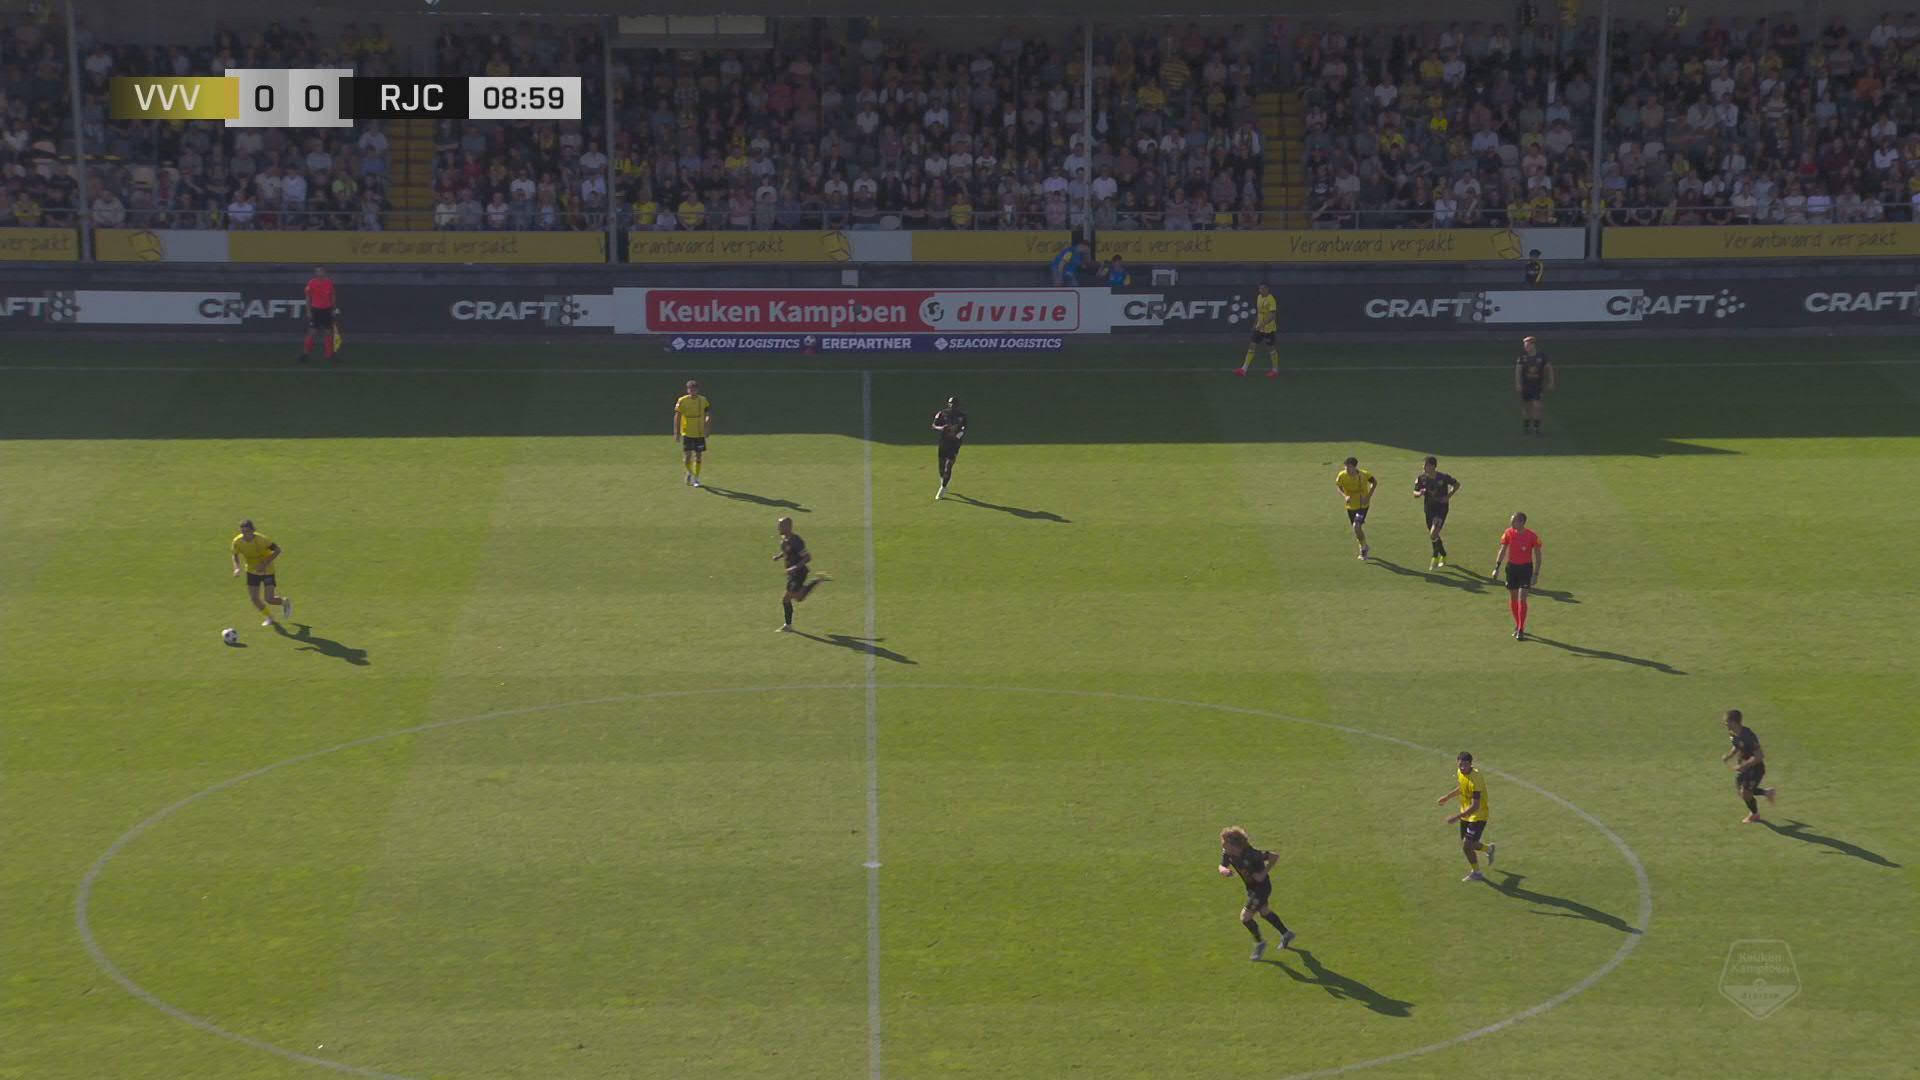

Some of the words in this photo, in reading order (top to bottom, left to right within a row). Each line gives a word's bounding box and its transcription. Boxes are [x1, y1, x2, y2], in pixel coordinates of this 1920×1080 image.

[1390, 234, 1456, 256] verpakt
[0, 297, 48, 316] AFT
[198, 298, 307, 319] CRAFT
[452, 300, 560, 320] CRAFT
[1123, 300, 1227, 320] CRAFT
[1364, 298, 1472, 318] CRAFT
[1605, 295, 1715, 316] CRAFT
[1804, 291, 1916, 312] CRAFT
[658, 299, 760, 323] Keuken
[768, 299, 907, 328] Kampioen
[956, 301, 1067, 322] divisie
[686, 338, 737, 349] SEACON
[738, 338, 800, 349] LOGISTICS
[822, 338, 911, 349] EREPARTNER
[949, 338, 998, 349] SEACON
[1000, 338, 1062, 349] LOGISTICS
